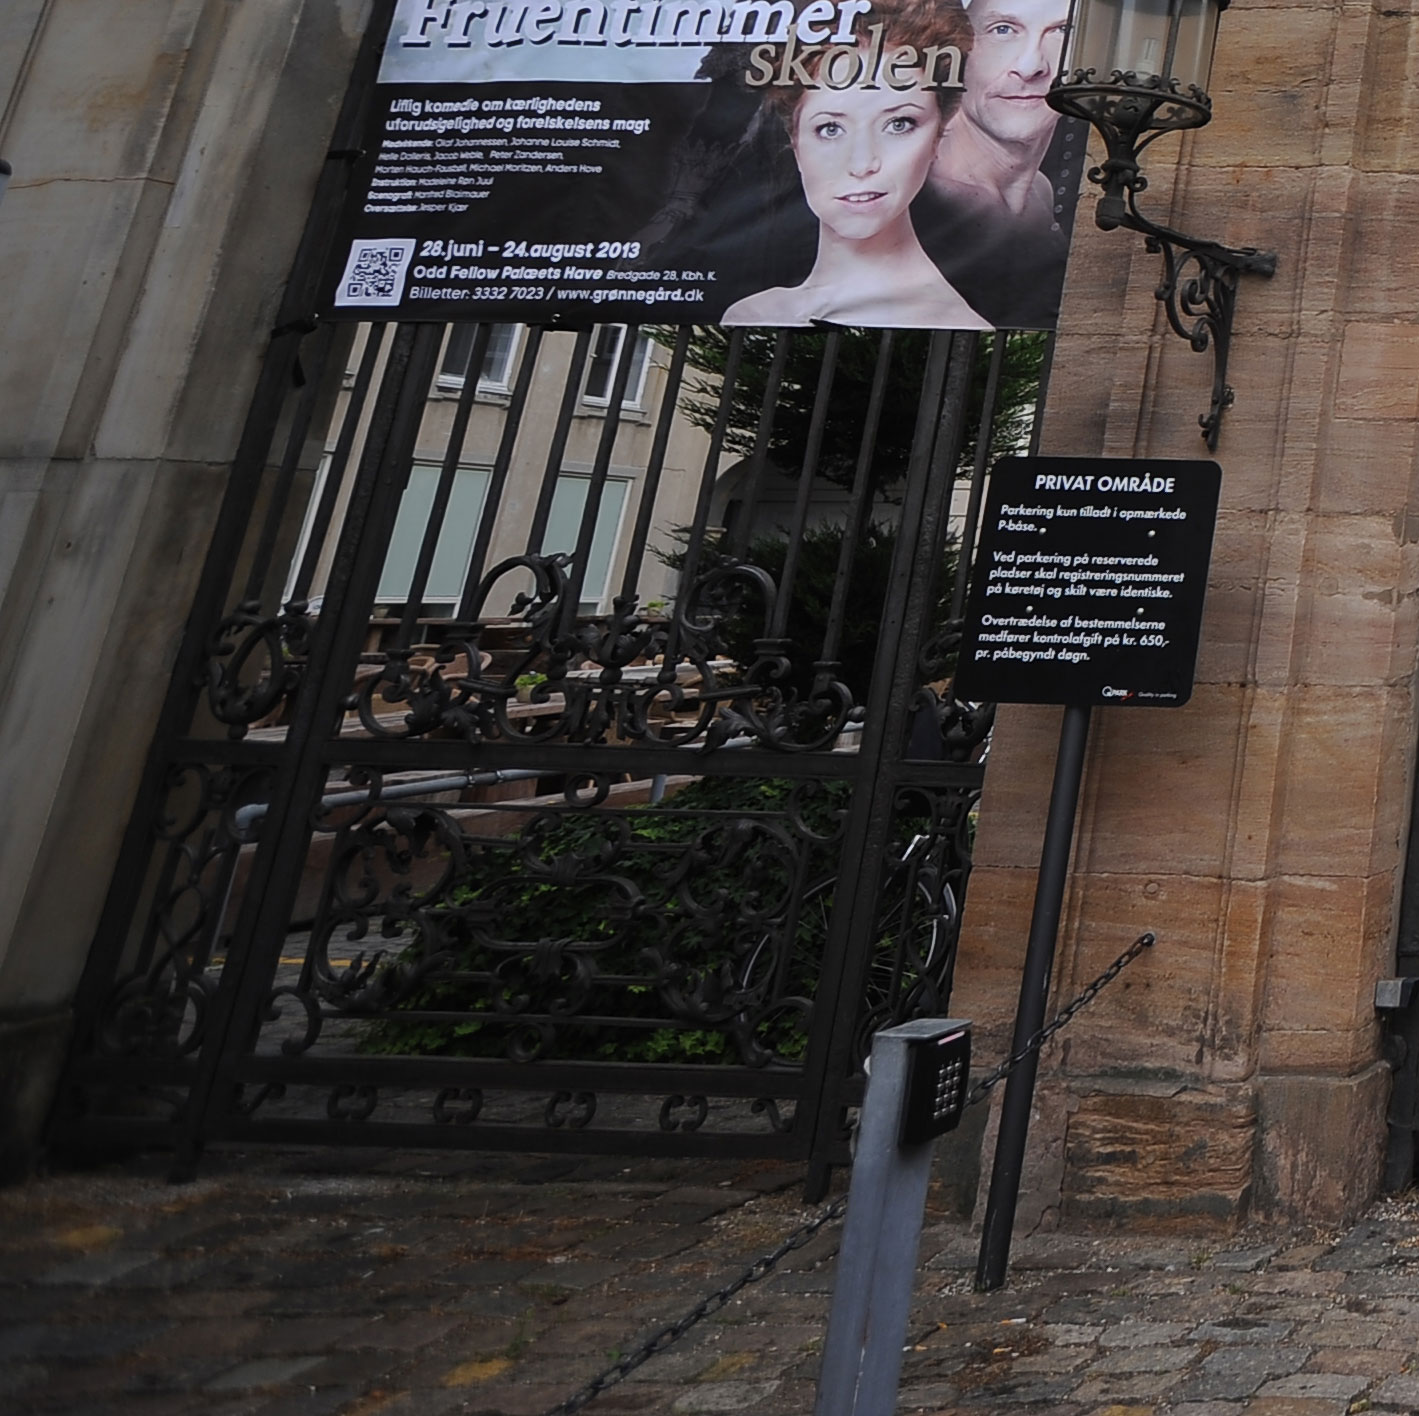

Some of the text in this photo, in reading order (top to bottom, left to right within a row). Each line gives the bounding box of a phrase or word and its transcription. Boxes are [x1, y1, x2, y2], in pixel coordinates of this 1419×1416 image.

[745, 24, 968, 91] skolen
[425, 98, 479, 112] komedie
[482, 100, 504, 111] om
[505, 97, 601, 114] kærlighedens
[386, 116, 650, 134] uforudsigelighed og forelskelsens magt
[545, 164, 578, 173] Anders
[419, 240, 485, 261] 28.juni
[501, 240, 594, 262] 24.august
[595, 241, 641, 259] 2013
[413, 265, 446, 280] Odd
[449, 265, 500, 280] Fellow
[501, 266, 561, 280] Palæets
[563, 266, 602, 280] Have
[606, 269, 661, 282] Bredgade
[663, 270, 679, 281] 28,
[473, 287, 507, 300] 3332
[510, 287, 544, 300] 7023
[556, 286, 704, 304] www.grønnegård.dk
[1034, 472, 1176, 493] PRIVAT OMRÅDE
[1000, 504, 1187, 521] Parkering kun tilladt i opmærkede
[998, 520, 1037, 532] P-båse.
[993, 550, 1159, 566] Ved parkering på reserverede
[988, 567, 1185, 584] pladser skal registreringsnummeret
[986, 583, 1173, 598] på køretøj og skilt være identiske.
[981, 614, 1166, 630] Overtrædelse af bestemmelserne
[978, 630, 1170, 648] medfører kontrolafgift på kr. 650,-
[975, 647, 1090, 663] pr. påbegyndt døgn.
